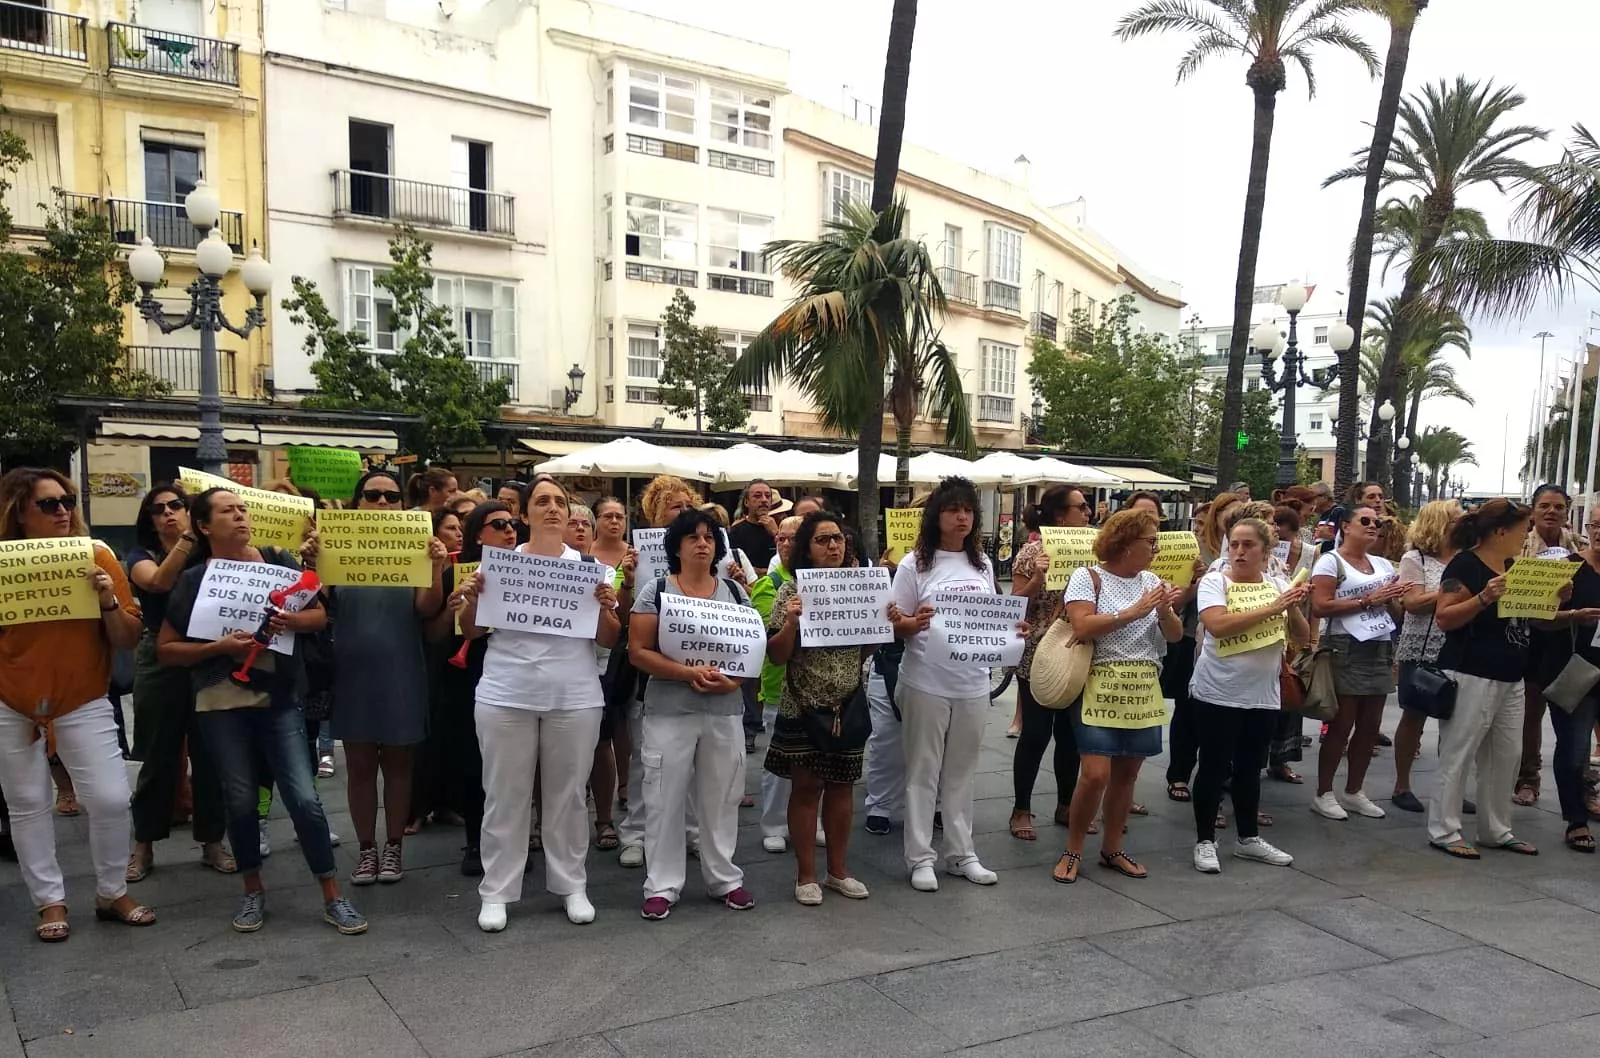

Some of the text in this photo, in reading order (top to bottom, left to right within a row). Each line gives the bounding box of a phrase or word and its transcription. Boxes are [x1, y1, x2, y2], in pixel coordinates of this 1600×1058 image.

[289, 497, 309, 506] DEL
[244, 500, 310, 518] SIN COBRAR
[249, 514, 296, 527] OMINAS
[321, 512, 427, 522] LIMPIADORAS DEL
[286, 532, 296, 541] Y
[320, 526, 429, 535] AYTO. SIN COBRAR
[892, 532, 915, 541] SUS
[60, 539, 85, 548] DEL
[324, 539, 426, 550] SUS NOMINAS
[1057, 548, 1072, 556] SUS
[1156, 553, 1196, 562] NOMINAS
[0, 551, 89, 568] SIN COBRAR
[339, 555, 412, 566] EXPERTUS
[489, 550, 575, 571] LIMPIADORAS
[578, 565, 601, 574] DEL
[1, 567, 87, 586] NOMINAS
[214, 561, 298, 582] LIMPIADORAS
[346, 572, 409, 583] NO PAGA
[488, 564, 524, 575] AYTO.
[528, 569, 546, 578] NO
[549, 572, 598, 585] COBRAN
[802, 569, 887, 580] LIMPIADORAS DEL
[208, 574, 244, 585] AYTO.
[247, 578, 270, 589] SIN
[500, 577, 585, 595] SUS NOMINAS
[801, 582, 888, 593] AYTO. SIN COBRAR
[208, 588, 238, 600] SUS
[1238, 595, 1256, 604] SIN
[1547, 590, 1554, 598] Y
[502, 591, 579, 611] EXPERTUS
[667, 595, 756, 615] LIMPIADORAS DEL
[812, 596, 876, 606] SUS NOMINAS
[935, 594, 1023, 608] LIMPIADORAS DEL
[23, 605, 71, 619] PAGA
[935, 606, 1021, 620] AYTO. NO COBRAN
[1515, 602, 1558, 613] CULPABLES
[506, 611, 572, 630] NO PAGA
[665, 609, 761, 626] AYTO. SIN COBRAR
[809, 609, 880, 621] EXPERTUS Y
[668, 623, 760, 639] SUS NOMINAS
[803, 626, 891, 638] AYTO. CULPABLES
[944, 620, 1008, 632] SUS NOMINAS
[947, 634, 1007, 646] EXPERTUS
[1219, 634, 1253, 649] AYTO.
[680, 640, 750, 655] EXPERTUS
[949, 652, 1003, 663] NO PAGA
[709, 659, 746, 673] PAGA
[1088, 669, 1118, 679] AYTO.
[1120, 671, 1138, 679] SIN
[1100, 682, 1119, 690] SUS
[1084, 708, 1120, 719] AYTO.
